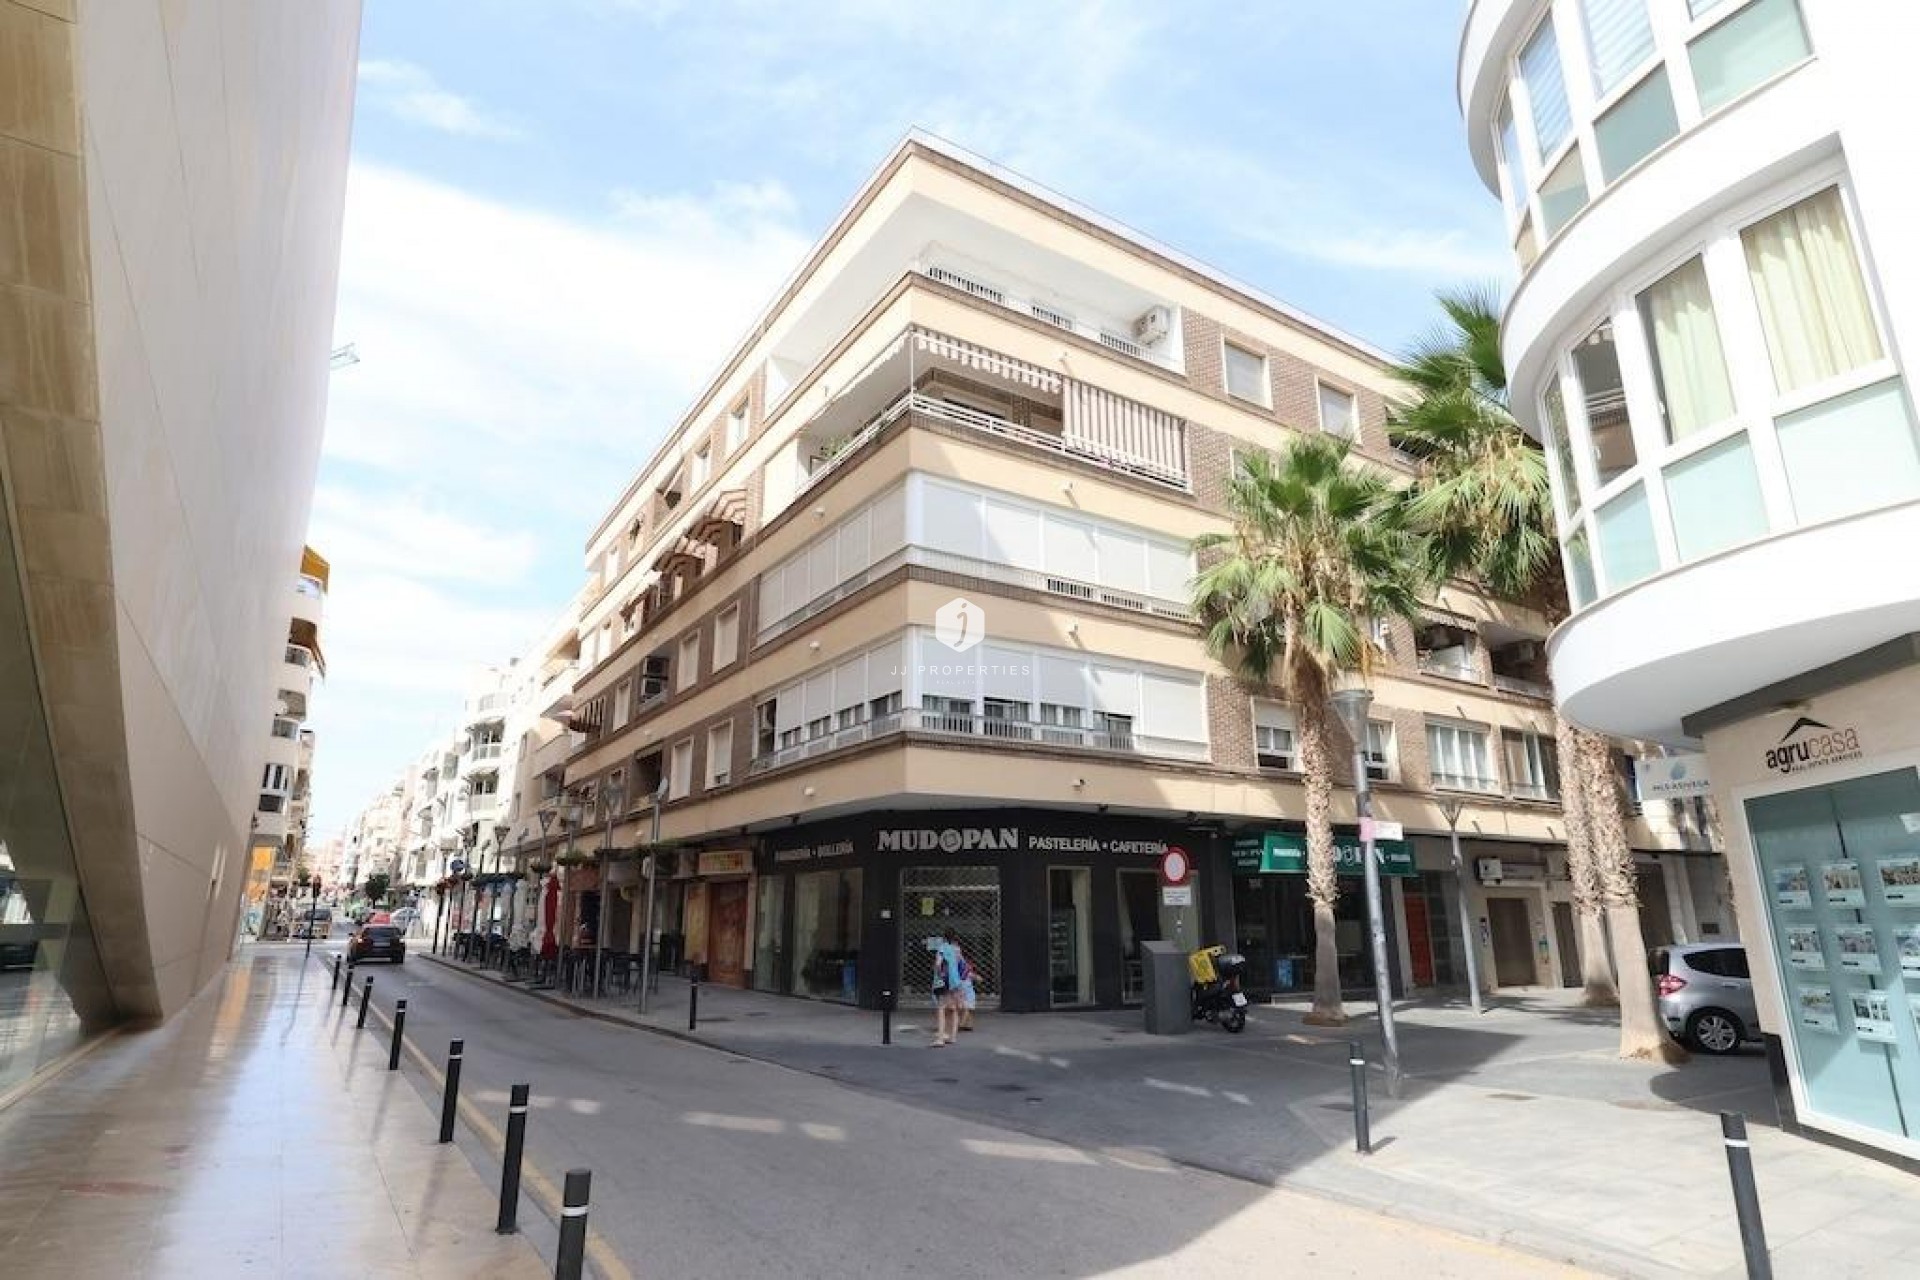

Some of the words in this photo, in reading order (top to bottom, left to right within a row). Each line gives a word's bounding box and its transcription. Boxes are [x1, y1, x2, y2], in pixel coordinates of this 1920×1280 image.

[1765, 728, 1860, 773] agrucasa
[877, 828, 1019, 853] MUDOPAN
[1028, 836, 1101, 852] PASTELERÍA
[1109, 840, 1168, 854] CAFETERÍA
